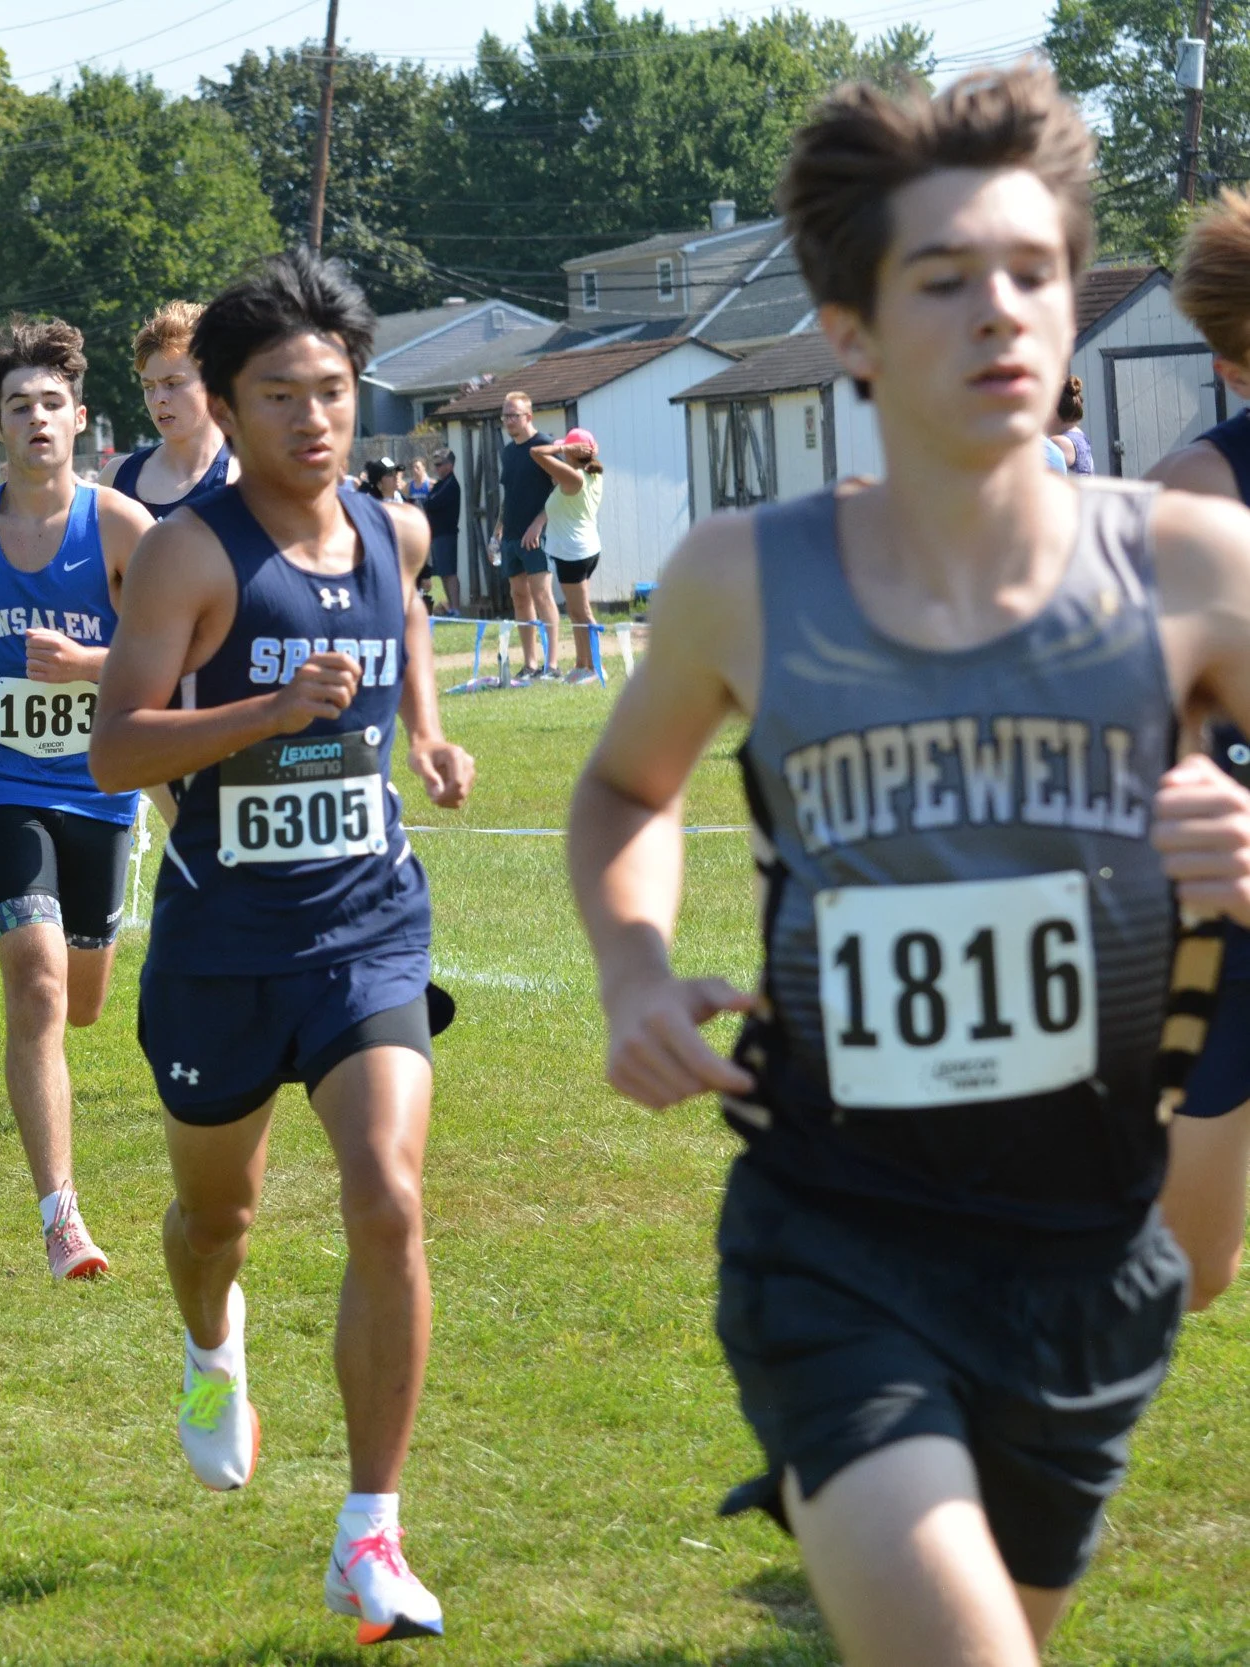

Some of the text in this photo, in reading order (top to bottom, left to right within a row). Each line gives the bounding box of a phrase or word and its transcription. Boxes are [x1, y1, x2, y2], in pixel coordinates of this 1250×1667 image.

[0, 692, 98, 738] 1683
[237, 789, 369, 851] 6305
[785, 716, 1150, 855] HOPEWELL
[833, 915, 1085, 1049] 1816
